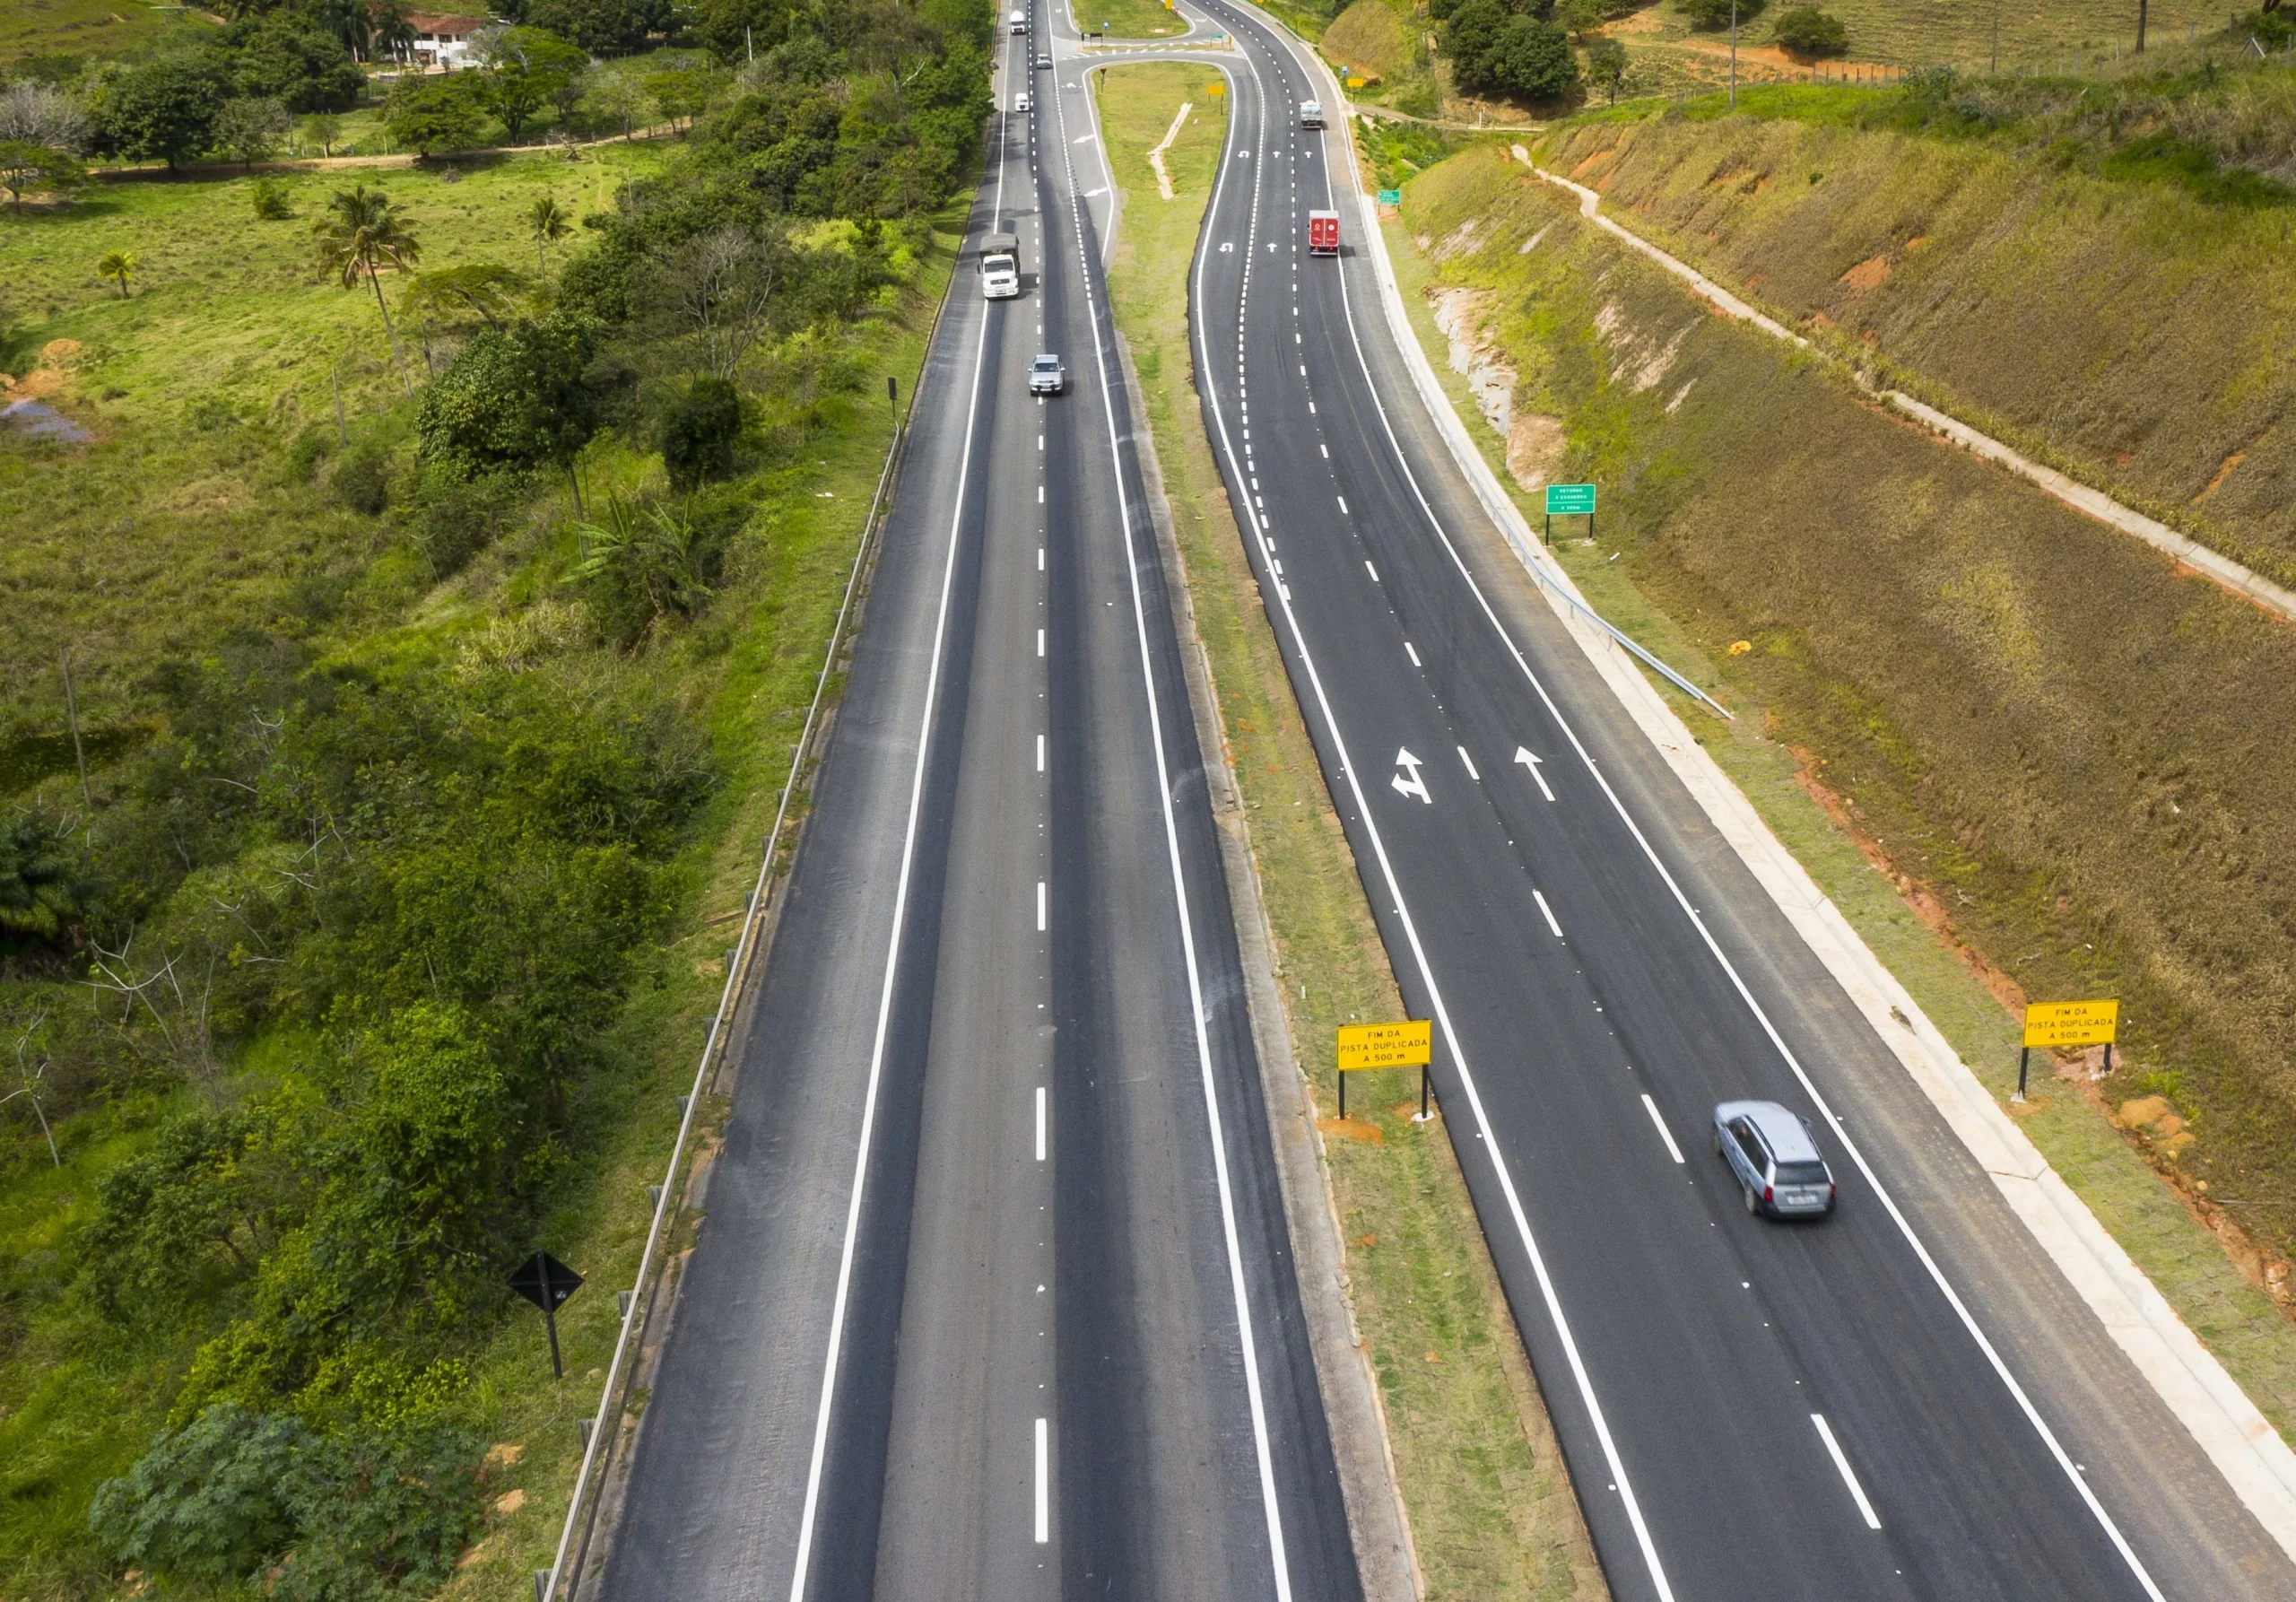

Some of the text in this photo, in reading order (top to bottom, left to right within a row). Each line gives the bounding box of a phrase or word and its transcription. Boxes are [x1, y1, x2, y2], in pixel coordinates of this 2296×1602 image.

[2074, 1007, 2088, 1015] DA
[2027, 1018, 2114, 1030] PISTA DUPLICADA
[1387, 1030, 1401, 1038] DA
[2060, 1031, 2078, 1039] 500
[1340, 1039, 1428, 1053] PISTA DUPLICADA
[1374, 1053, 1393, 1061] 500
